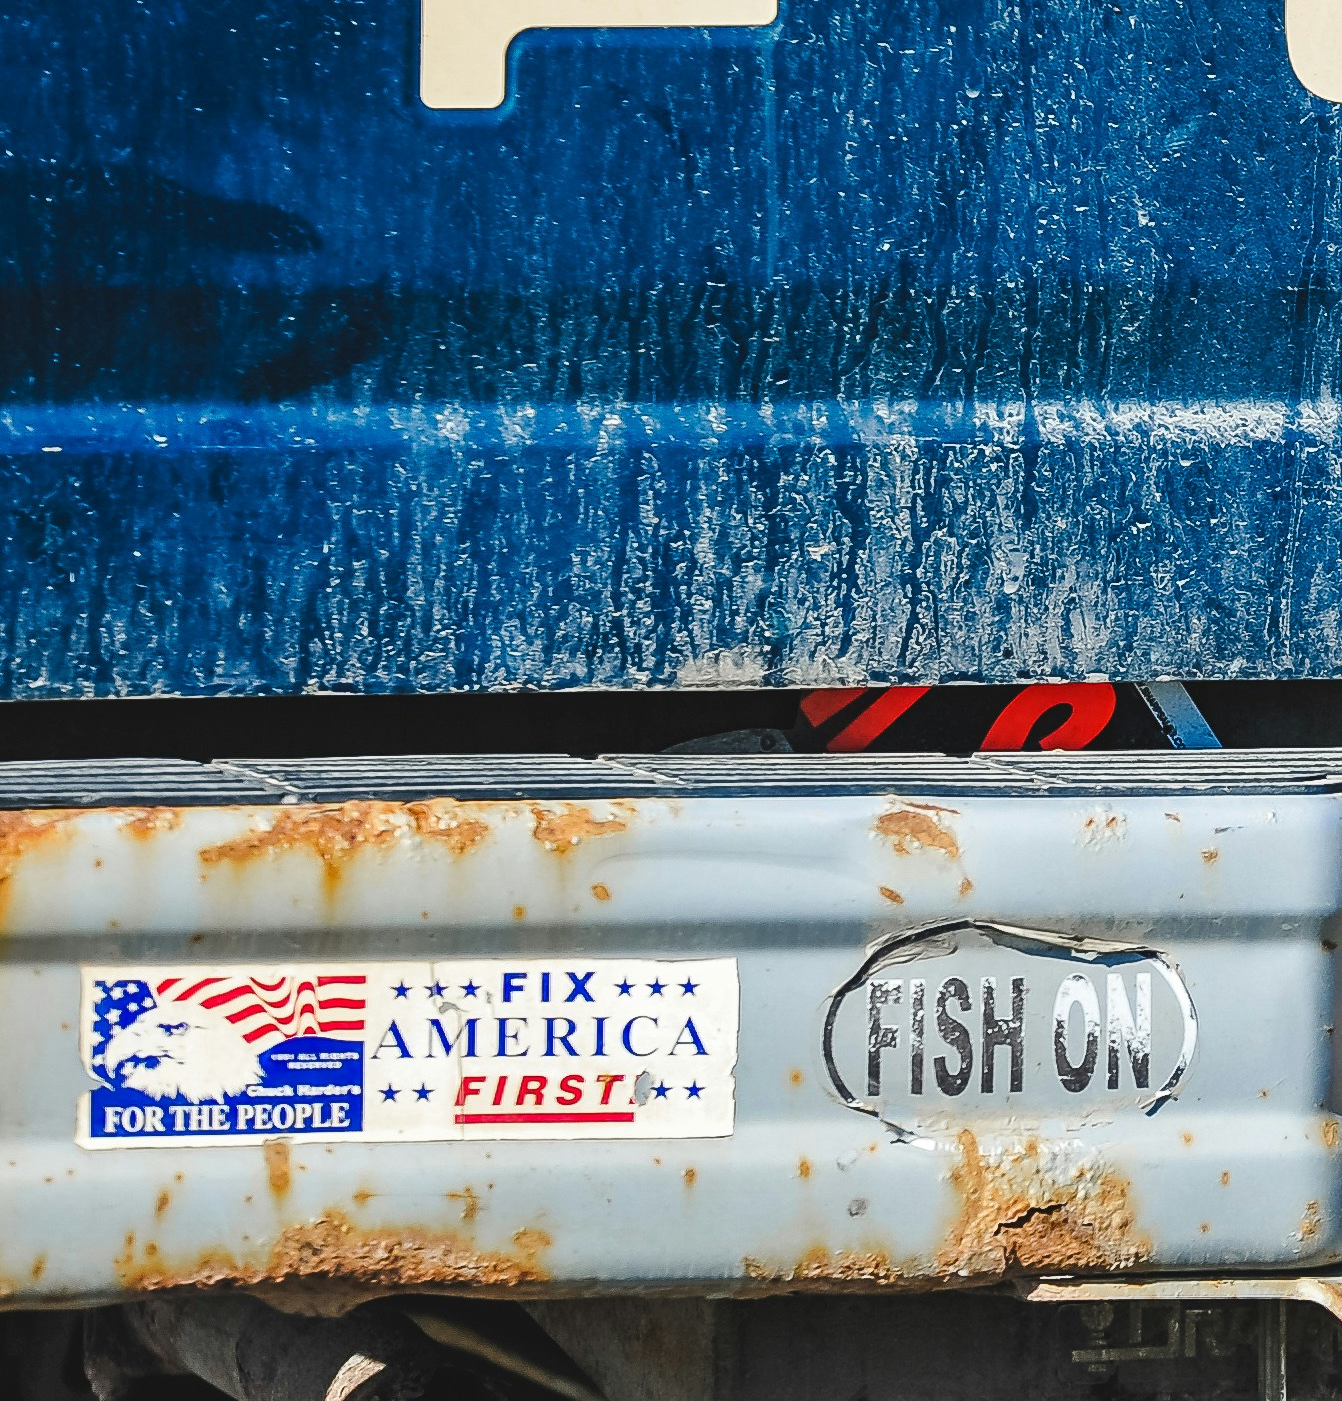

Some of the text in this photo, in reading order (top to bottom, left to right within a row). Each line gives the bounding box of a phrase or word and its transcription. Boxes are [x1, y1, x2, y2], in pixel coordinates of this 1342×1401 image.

[502, 972, 597, 1003] FIX
[370, 1015, 710, 1060] AMERICA
[865, 972, 1153, 1098] FISH ON
[103, 1102, 351, 1133] FOR THE PEOPLE
